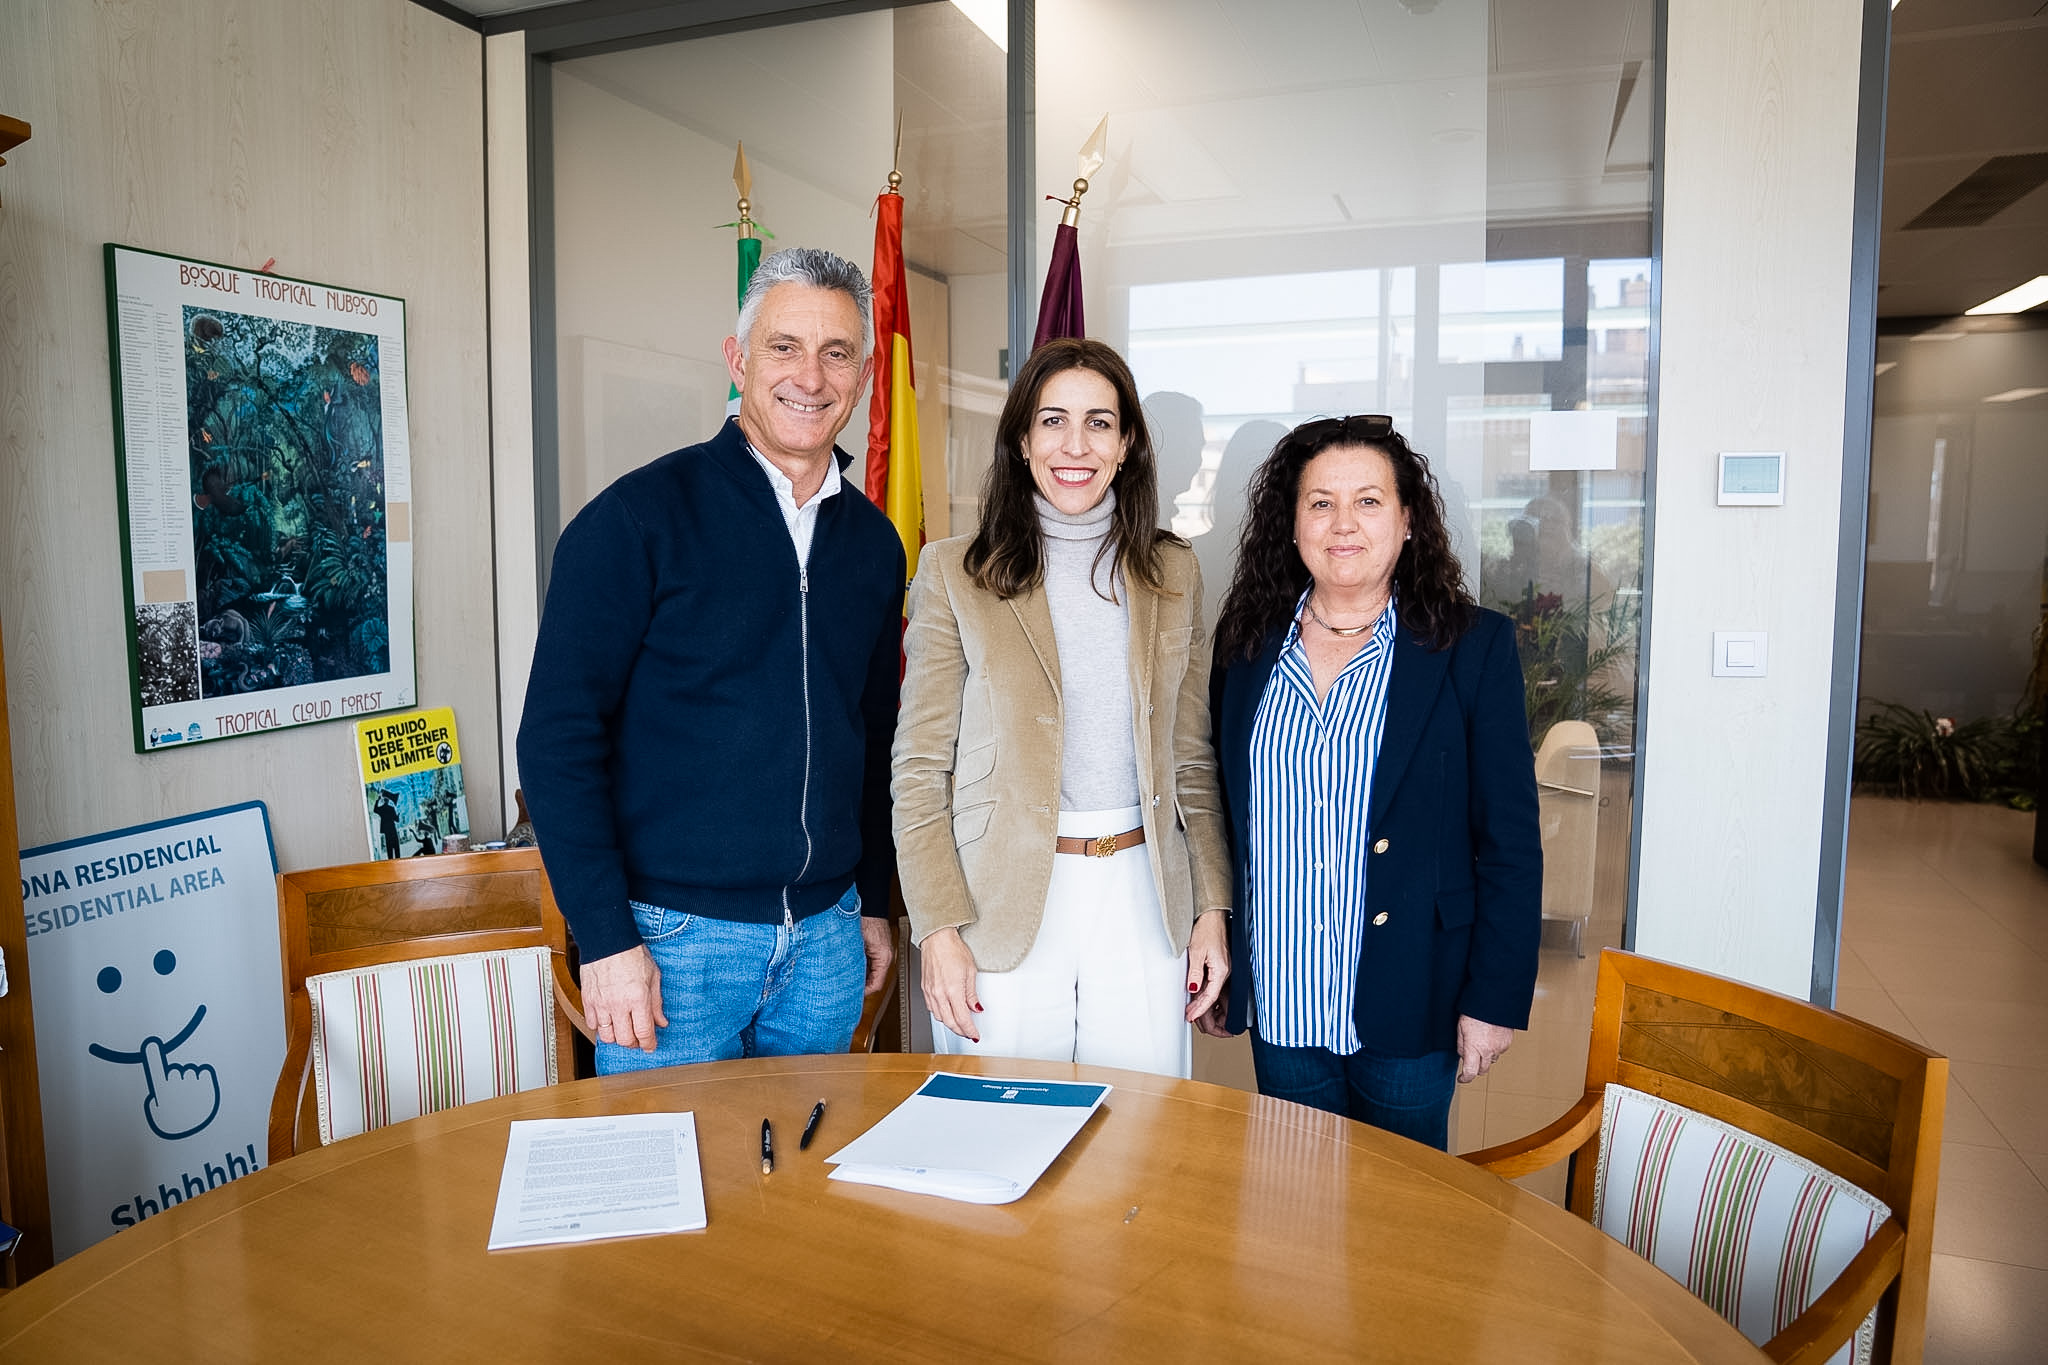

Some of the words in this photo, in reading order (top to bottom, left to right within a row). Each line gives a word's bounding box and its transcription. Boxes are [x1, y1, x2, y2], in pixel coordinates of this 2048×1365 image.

[180, 264, 240, 294] BOSQUE
[252, 278, 316, 307] TROPICAL
[327, 291, 378, 317] NUBOSO
[216, 708, 282, 736] TROPICAL
[293, 700, 331, 723] CLOUD
[341, 691, 383, 715] FOREST
[365, 729, 383, 744] TU
[387, 718, 426, 739] RUIDO
[368, 738, 404, 759] DEBE
[407, 727, 449, 747] TENER
[371, 757, 391, 774] UN
[74, 834, 222, 887] RESIDENCIAL
[24, 883, 164, 938] ESIDENTIAL
[169, 866, 226, 899] AREA
[111, 1143, 259, 1234] Shhhhh!
